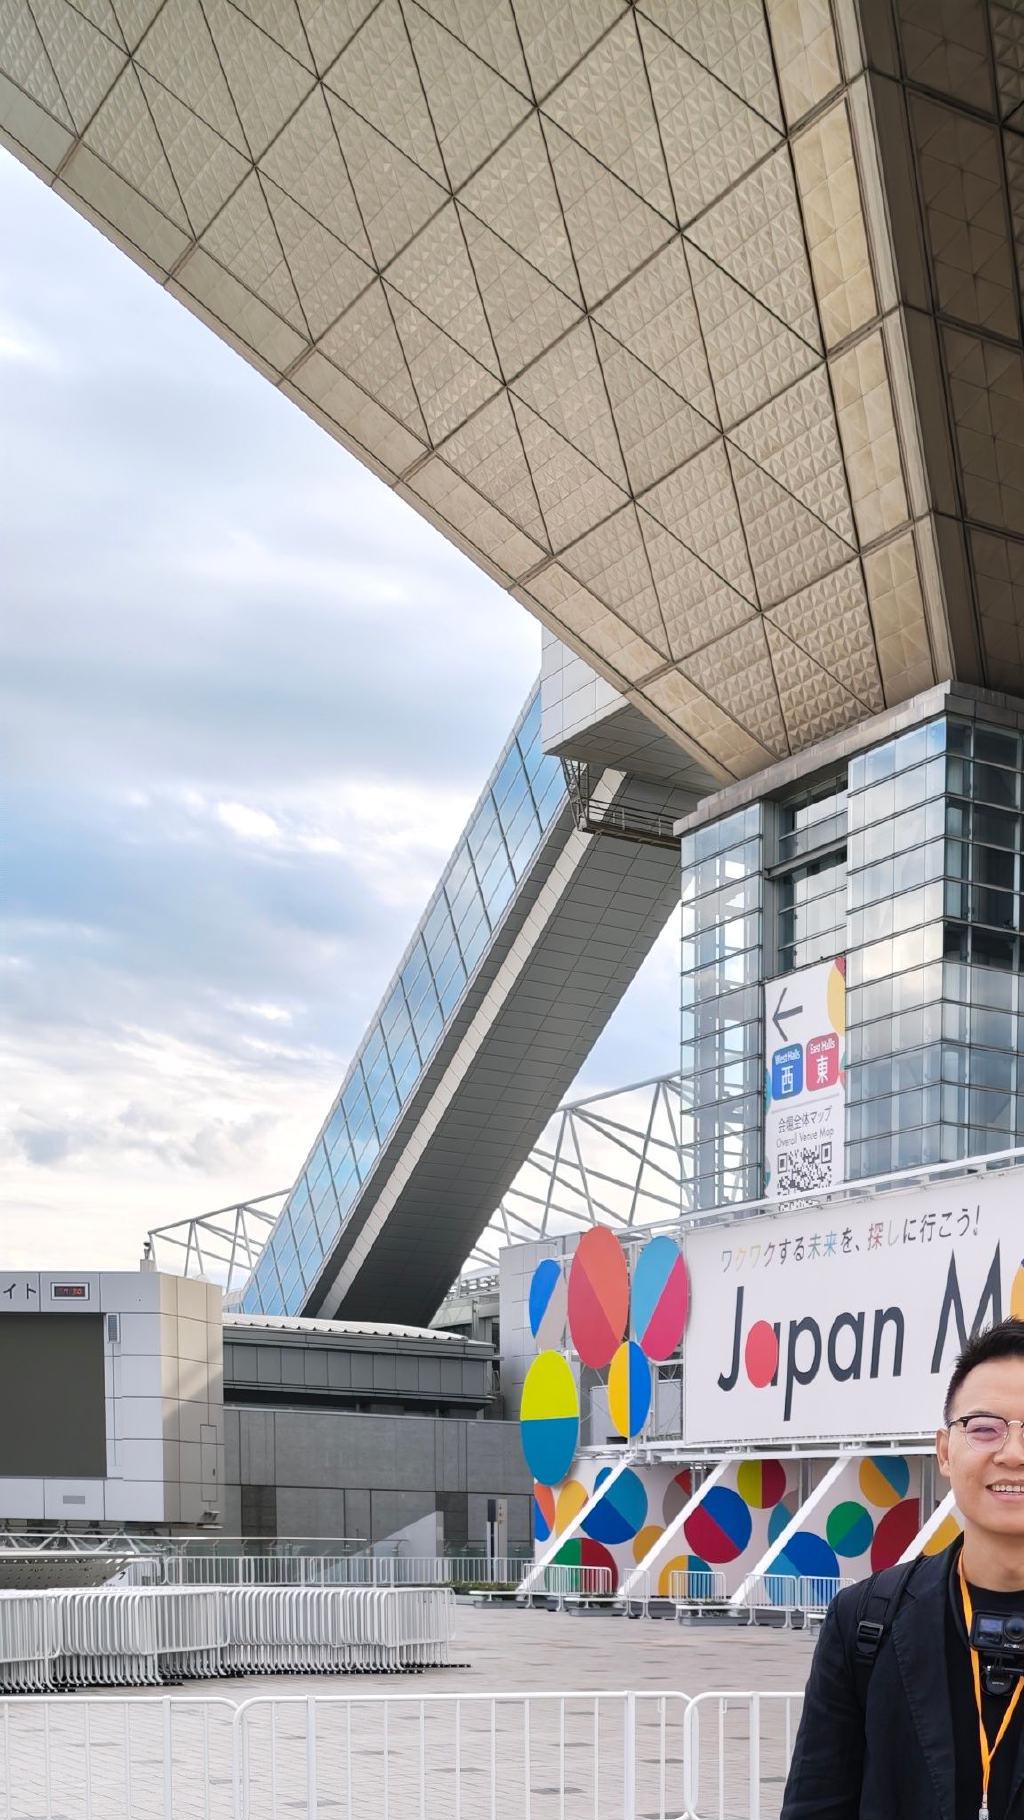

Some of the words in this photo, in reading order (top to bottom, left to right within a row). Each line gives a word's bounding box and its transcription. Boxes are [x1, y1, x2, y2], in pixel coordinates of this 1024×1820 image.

[781, 1065, 794, 1094] 西
[816, 1055, 829, 1084] 東
[819, 1127, 834, 1141] Map
[3, 1283, 37, 1300] イト
[717, 1286, 905, 1421] Japan
